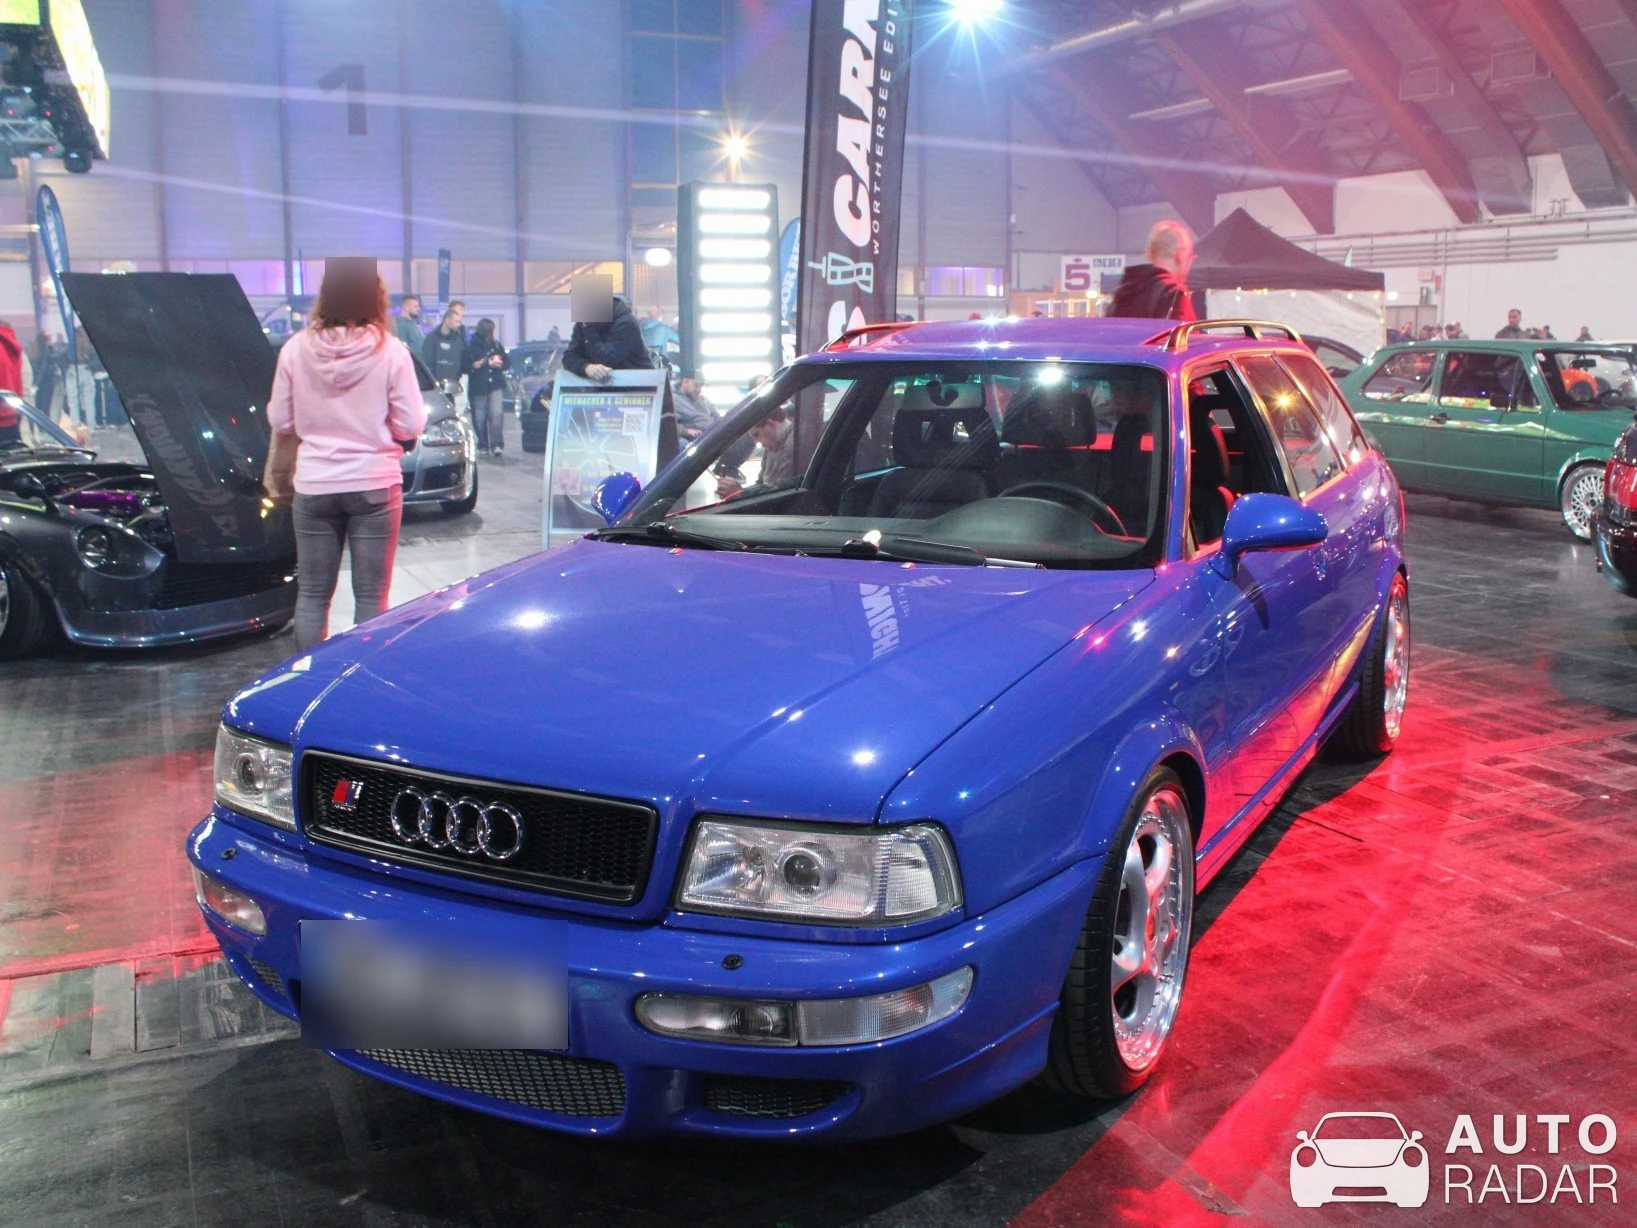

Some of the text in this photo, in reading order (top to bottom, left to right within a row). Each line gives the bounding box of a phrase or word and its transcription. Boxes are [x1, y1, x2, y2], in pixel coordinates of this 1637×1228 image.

[883, 0, 900, 54] EDI
[317, 63, 367, 135] 1
[1064, 263, 1091, 290] 5
